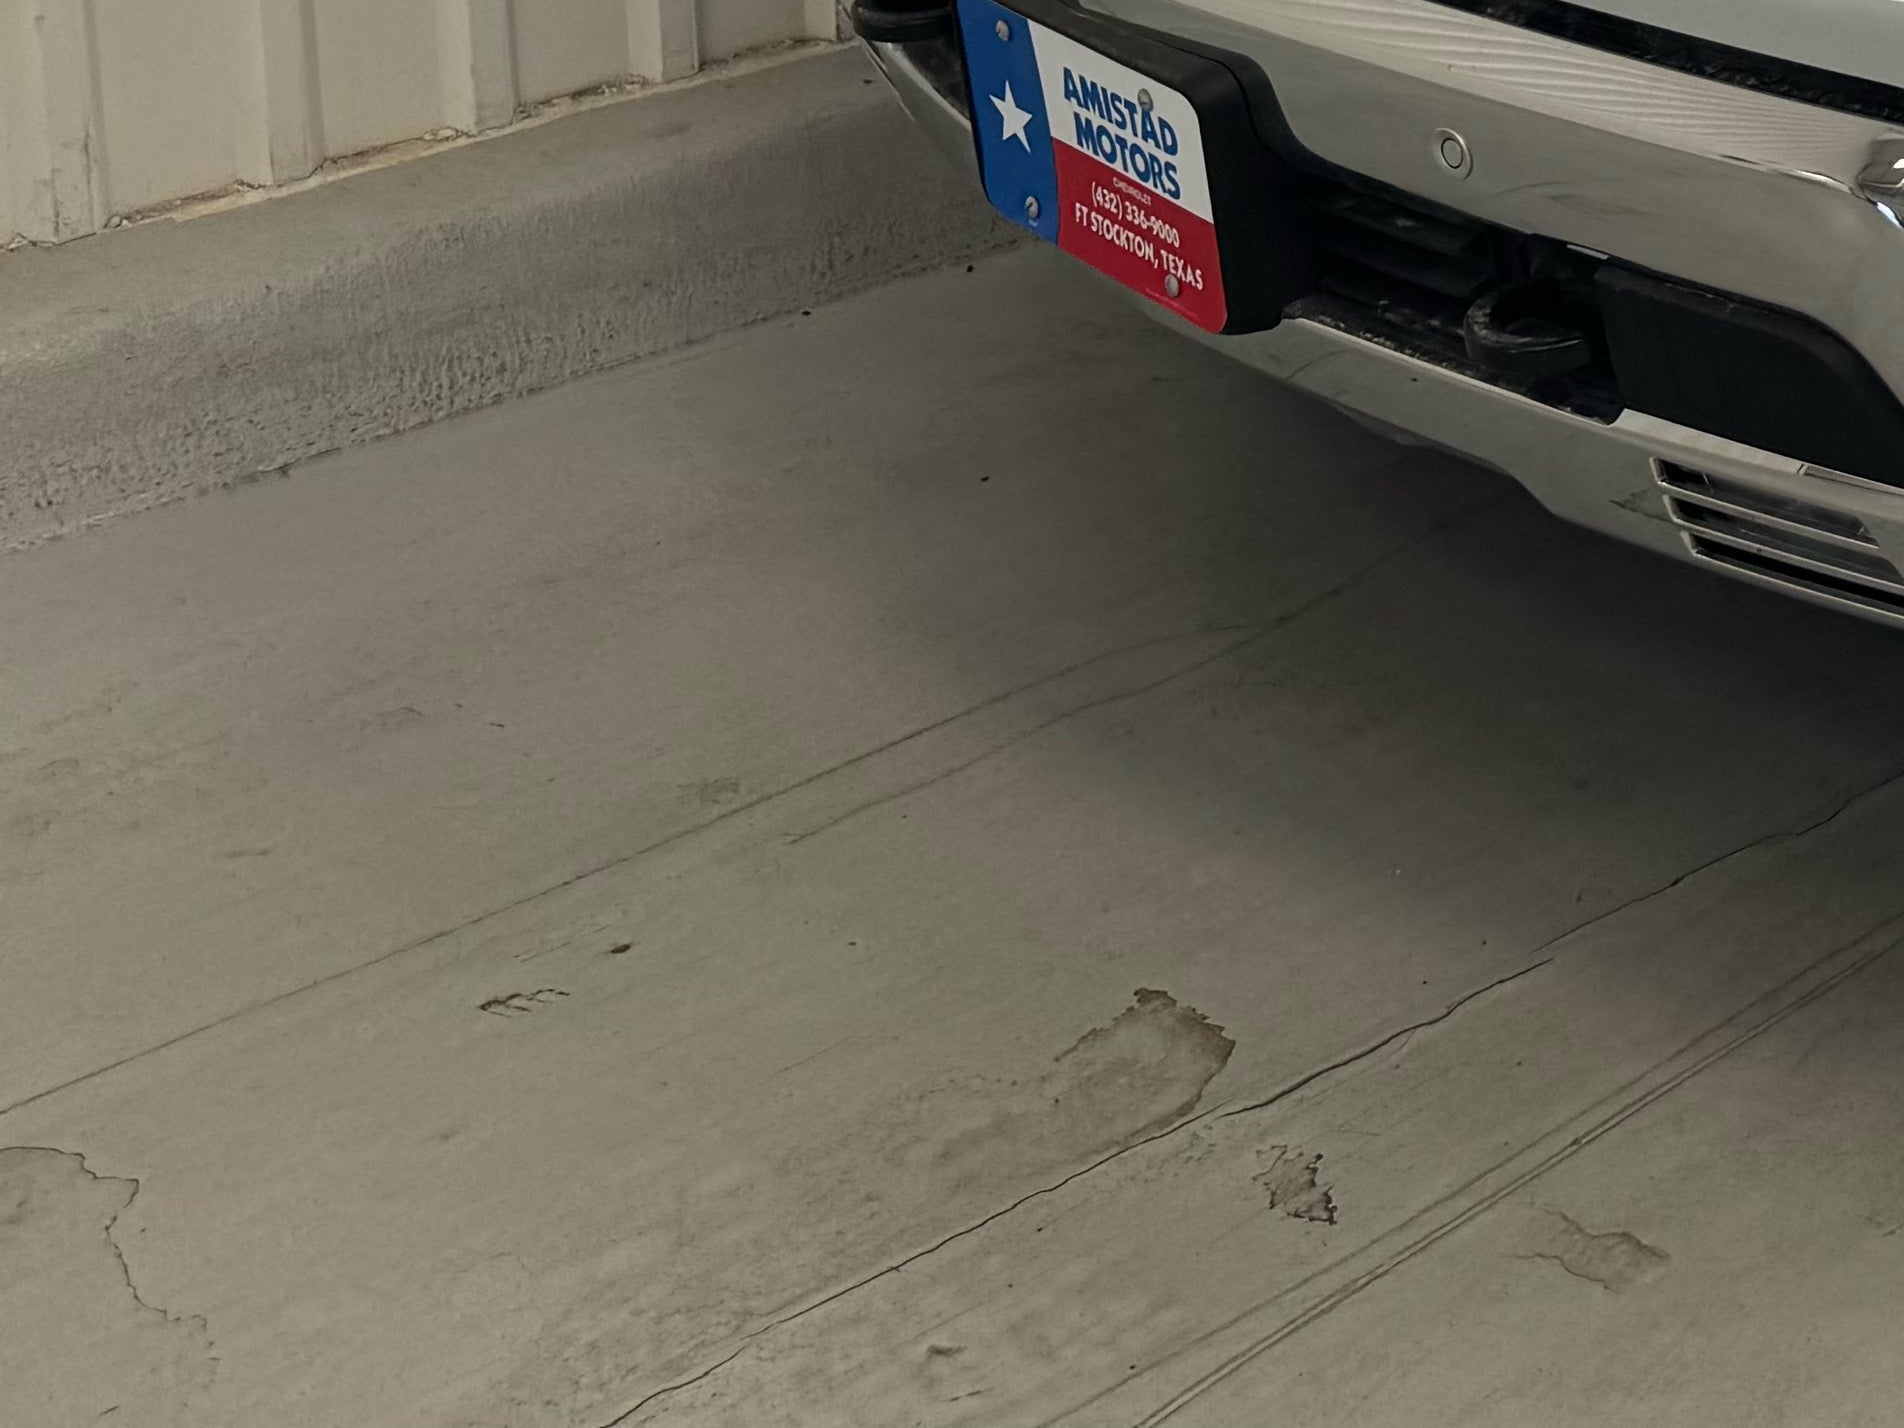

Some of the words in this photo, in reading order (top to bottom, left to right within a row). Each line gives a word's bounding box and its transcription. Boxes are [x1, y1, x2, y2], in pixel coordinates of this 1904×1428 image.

[1063, 66, 1179, 156] AMISTAD
[1073, 111, 1181, 200] MOTORS
[1075, 202, 1088, 226] FT
[1090, 211, 1159, 269] STOCKTON,
[1160, 249, 1203, 290] TEXAS
[1091, 181, 1123, 220] (432)
[1125, 201, 1180, 248] 336-9000
